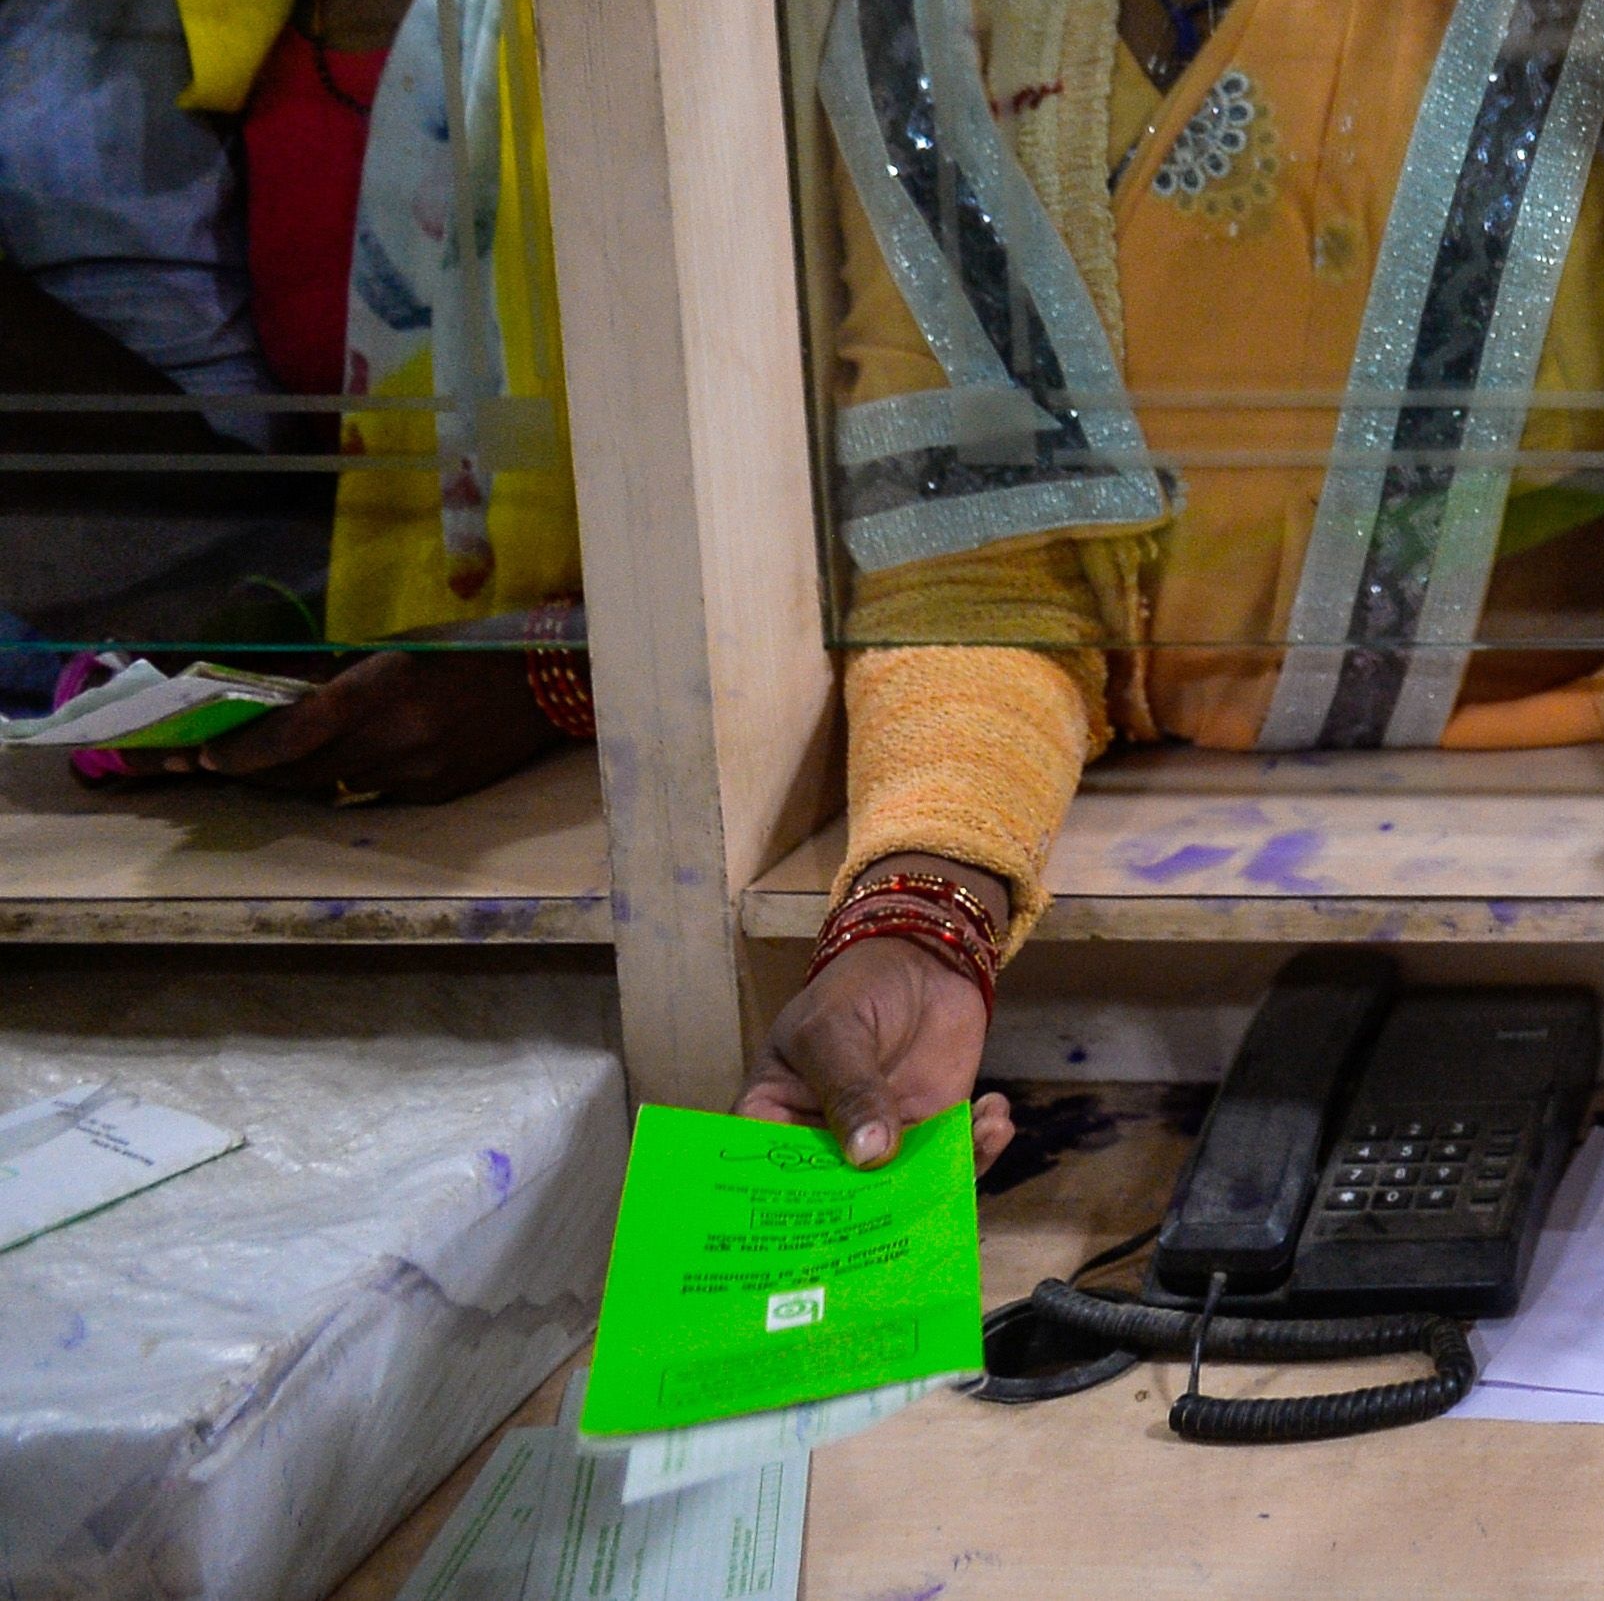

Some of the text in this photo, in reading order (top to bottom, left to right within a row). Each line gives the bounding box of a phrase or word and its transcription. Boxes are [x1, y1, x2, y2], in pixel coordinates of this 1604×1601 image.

[1358, 1147, 1370, 1158] 4
[1401, 1145, 1413, 1157] 5
[1350, 1168, 1362, 1180] 7
[1394, 1168, 1406, 1179] 8
[1386, 1191, 1399, 1202] 0
